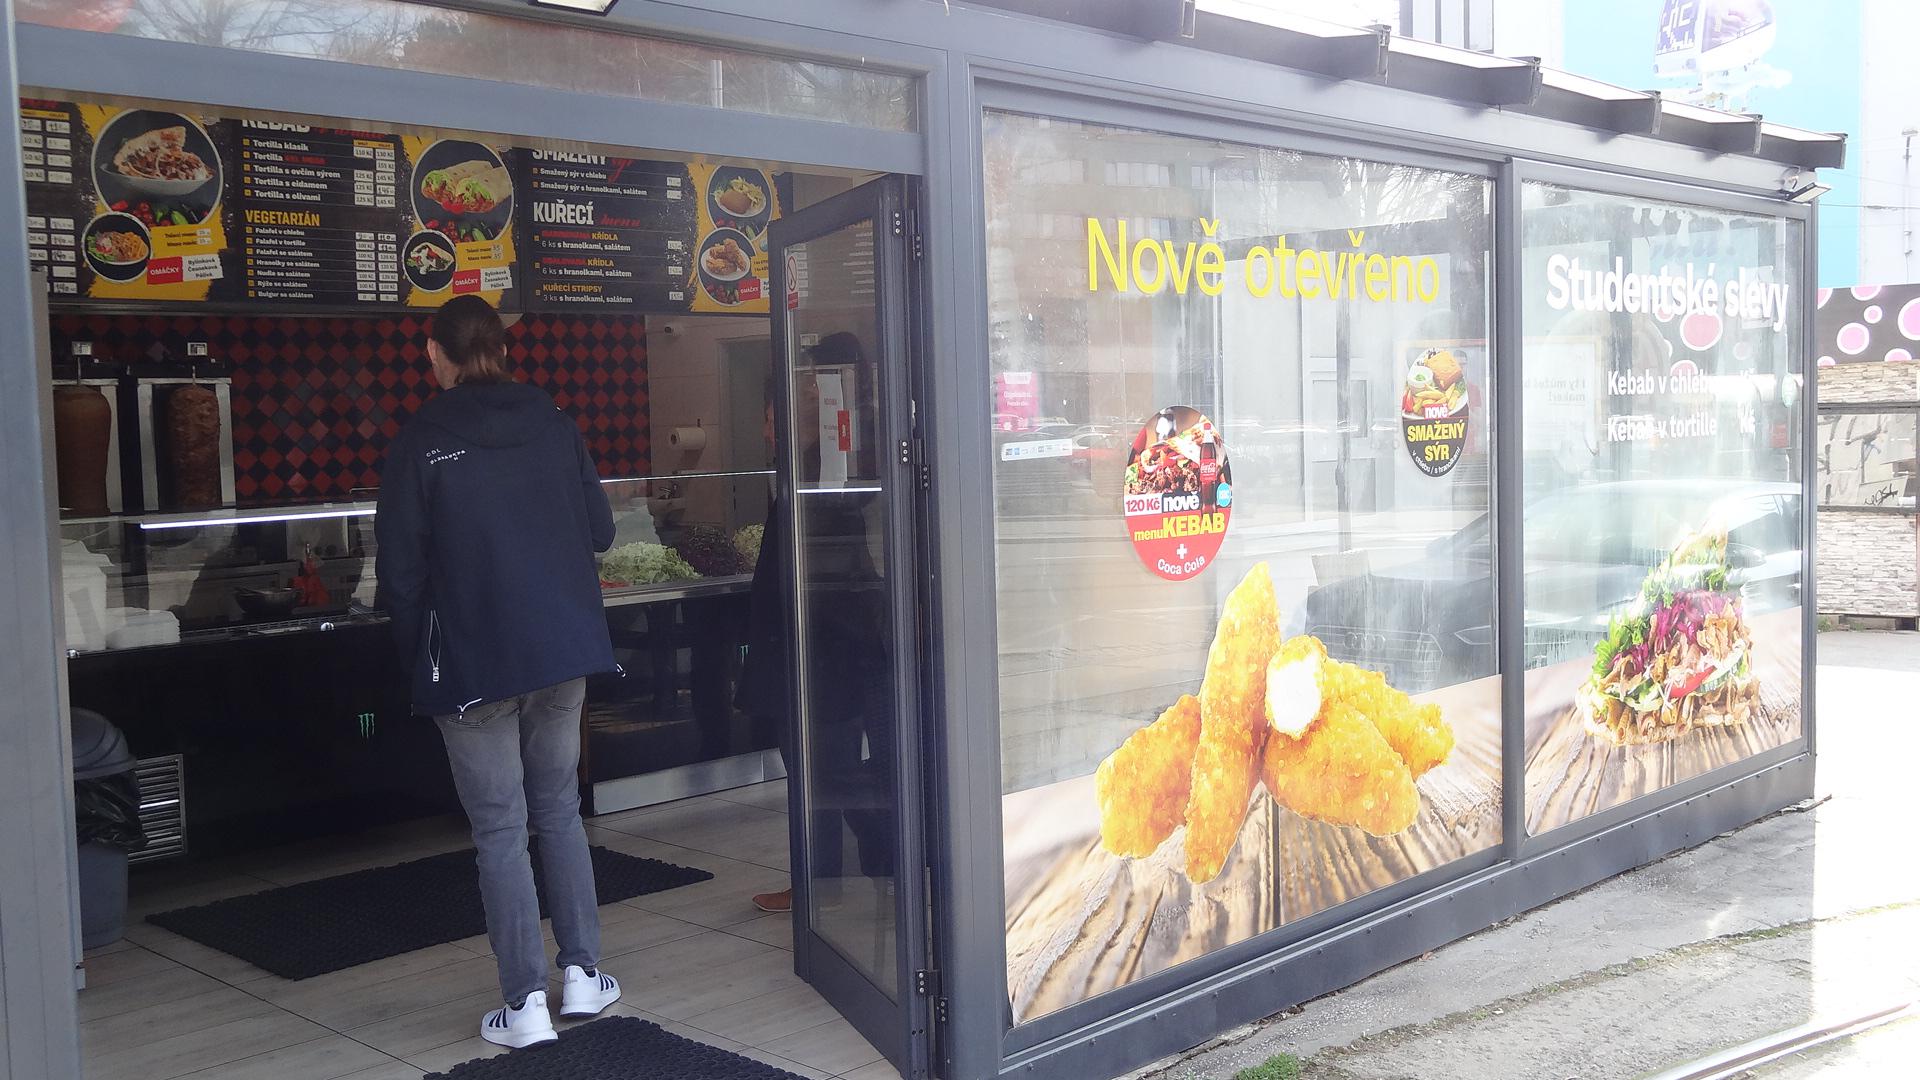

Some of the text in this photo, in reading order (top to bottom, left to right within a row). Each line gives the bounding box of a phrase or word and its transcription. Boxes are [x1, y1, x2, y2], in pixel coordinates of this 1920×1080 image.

[253, 139, 309, 152] Tortilla klasik
[253, 152, 283, 161] Tortilla
[254, 164, 283, 174] Tortilla
[291, 168, 314, 176] ovčím
[316, 170, 341, 179] sýrem
[540, 168, 568, 178] Smažený
[569, 171, 579, 179] sýr
[254, 177, 284, 187] Tortilla
[291, 180, 328, 190] eidamem
[540, 182, 568, 191] Smažený
[585, 185, 622, 194] hranolkami,
[254, 190, 284, 199] Tortilla
[292, 193, 321, 201] olivami
[245, 210, 320, 226] VEGETARIÁN
[533, 199, 594, 225] KUŘECÍ
[255, 227, 277, 235] Falafel
[592, 231, 618, 241] KŘÍDLA
[548, 240, 556, 248] ks
[562, 241, 603, 251] hranolkami,
[604, 244, 631, 252] salátem
[256, 259, 285, 267] Hranolky
[587, 257, 614, 267] KŘÍDLA
[1086, 217, 1440, 304] Nově otevřeno
[150, 266, 179, 276] OMÁČKY
[564, 268, 604, 278] hranolkami,
[257, 280, 273, 288] Rýže
[455, 277, 478, 286] OMÁČKY
[543, 282, 603, 293] KUŘECÍ STRIPSY
[564, 295, 605, 303] hranolkami,
[1546, 253, 1790, 333] Studentské slevy
[1607, 369, 1655, 396] Kebab
[1658, 375, 1667, 394] v
[1670, 368, 1717, 395] chleb
[1425, 403, 1448, 419] nově
[1407, 419, 1465, 443] SMAŽENÝ
[1607, 416, 1655, 442] Kebab
[1656, 420, 1668, 439] v
[1670, 411, 1717, 438] tortille
[1424, 441, 1450, 462] SÝR
[1415, 456, 1431, 473] chlebu
[1438, 446, 1462, 473] hranolkami
[1126, 497, 1160, 513] 120 Kč
[1163, 491, 1200, 513] nově
[1157, 555, 1206, 575] Coca Cola
